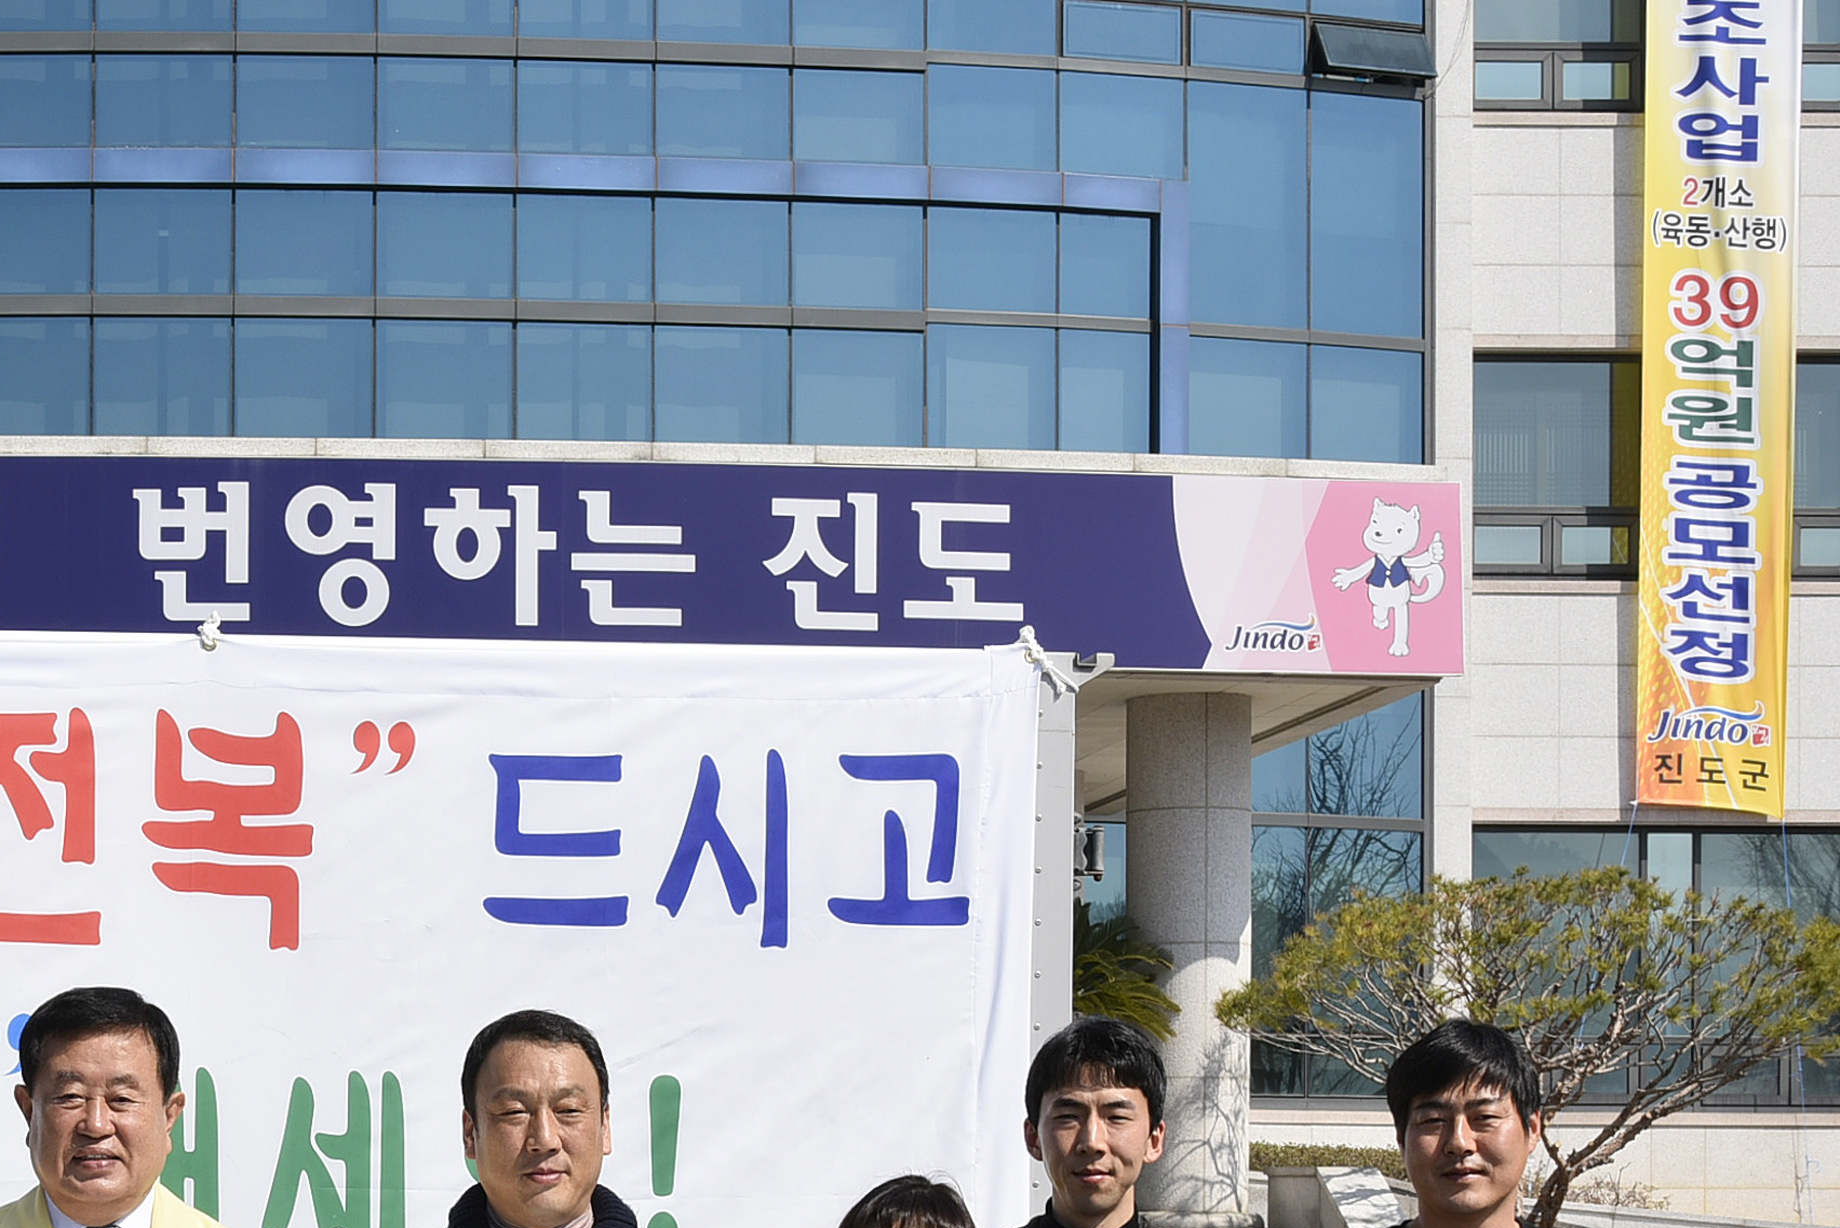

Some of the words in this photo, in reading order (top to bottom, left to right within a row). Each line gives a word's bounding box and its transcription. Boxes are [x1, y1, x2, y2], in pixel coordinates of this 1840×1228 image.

[1682, 176, 1755, 210] 2개소
[133, 481, 696, 627] 번영하는
[763, 492, 1025, 631] 진도
[1667, 460, 1758, 679] 공모선정
[1224, 625, 1305, 651] Jindo
[1647, 711, 1749, 744] Jindo
[483, 747, 971, 950] 드시고
